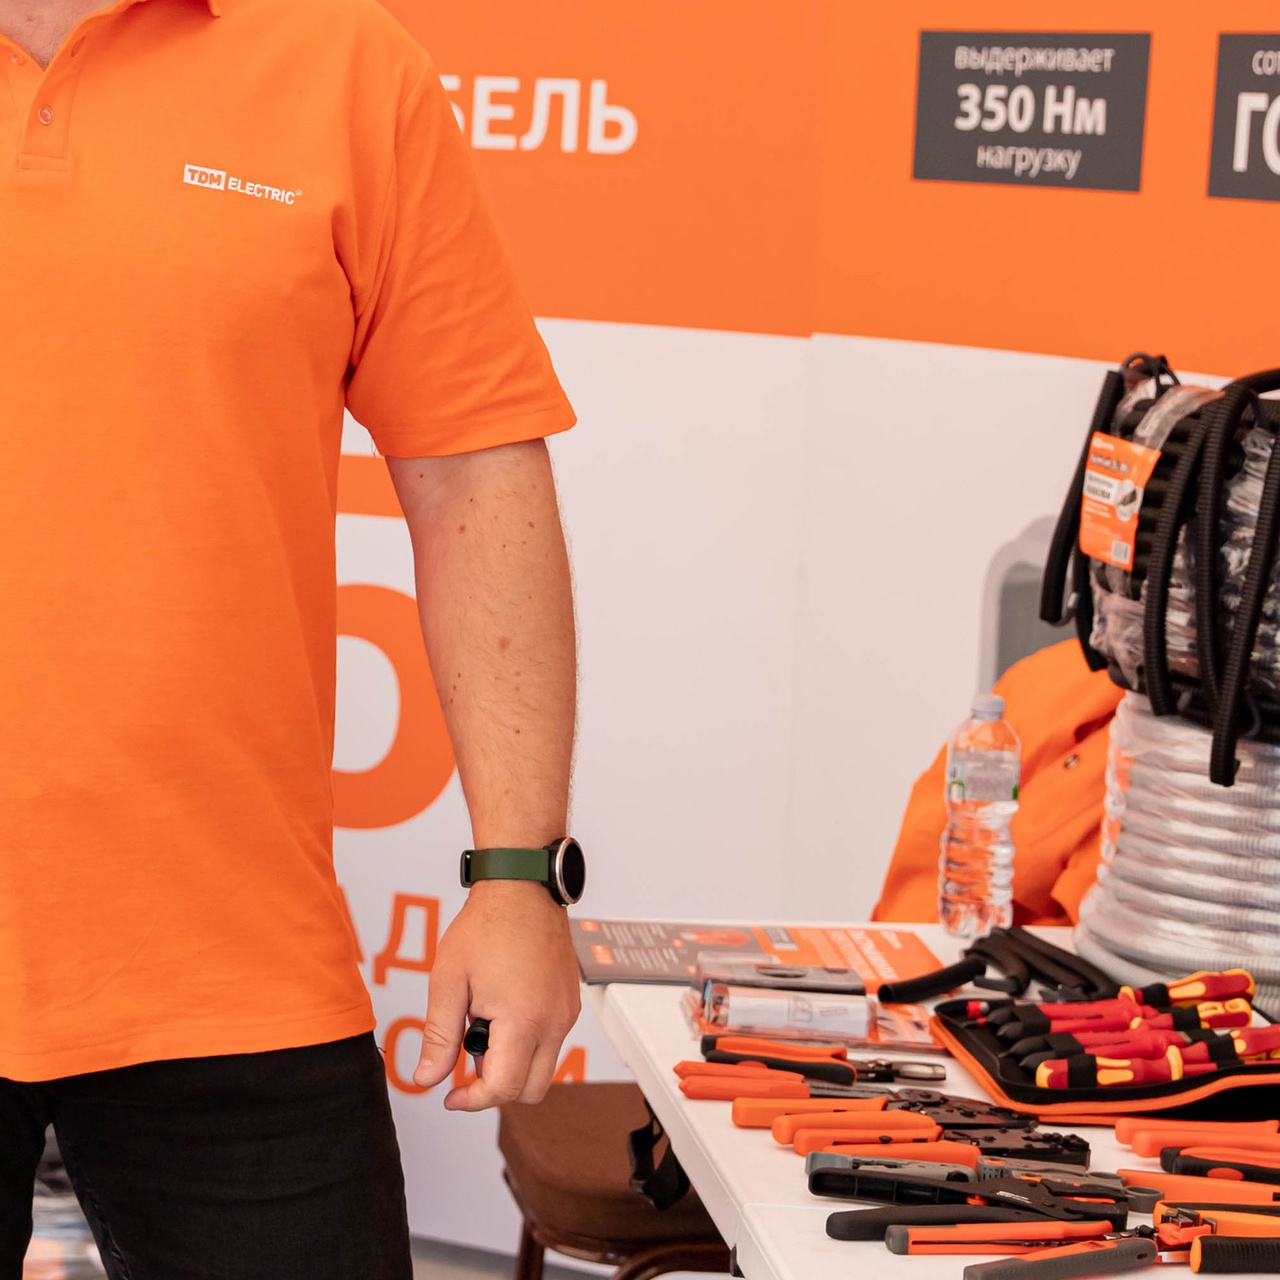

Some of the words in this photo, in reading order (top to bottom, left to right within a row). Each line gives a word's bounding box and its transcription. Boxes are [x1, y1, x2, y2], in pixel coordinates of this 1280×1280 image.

[953, 45, 1115, 77] выдерживает
[954, 82, 1037, 135] 350
[1042, 84, 1108, 136] Нм
[186, 167, 223, 187] TDM
[976, 145, 1083, 181] нагрузку
